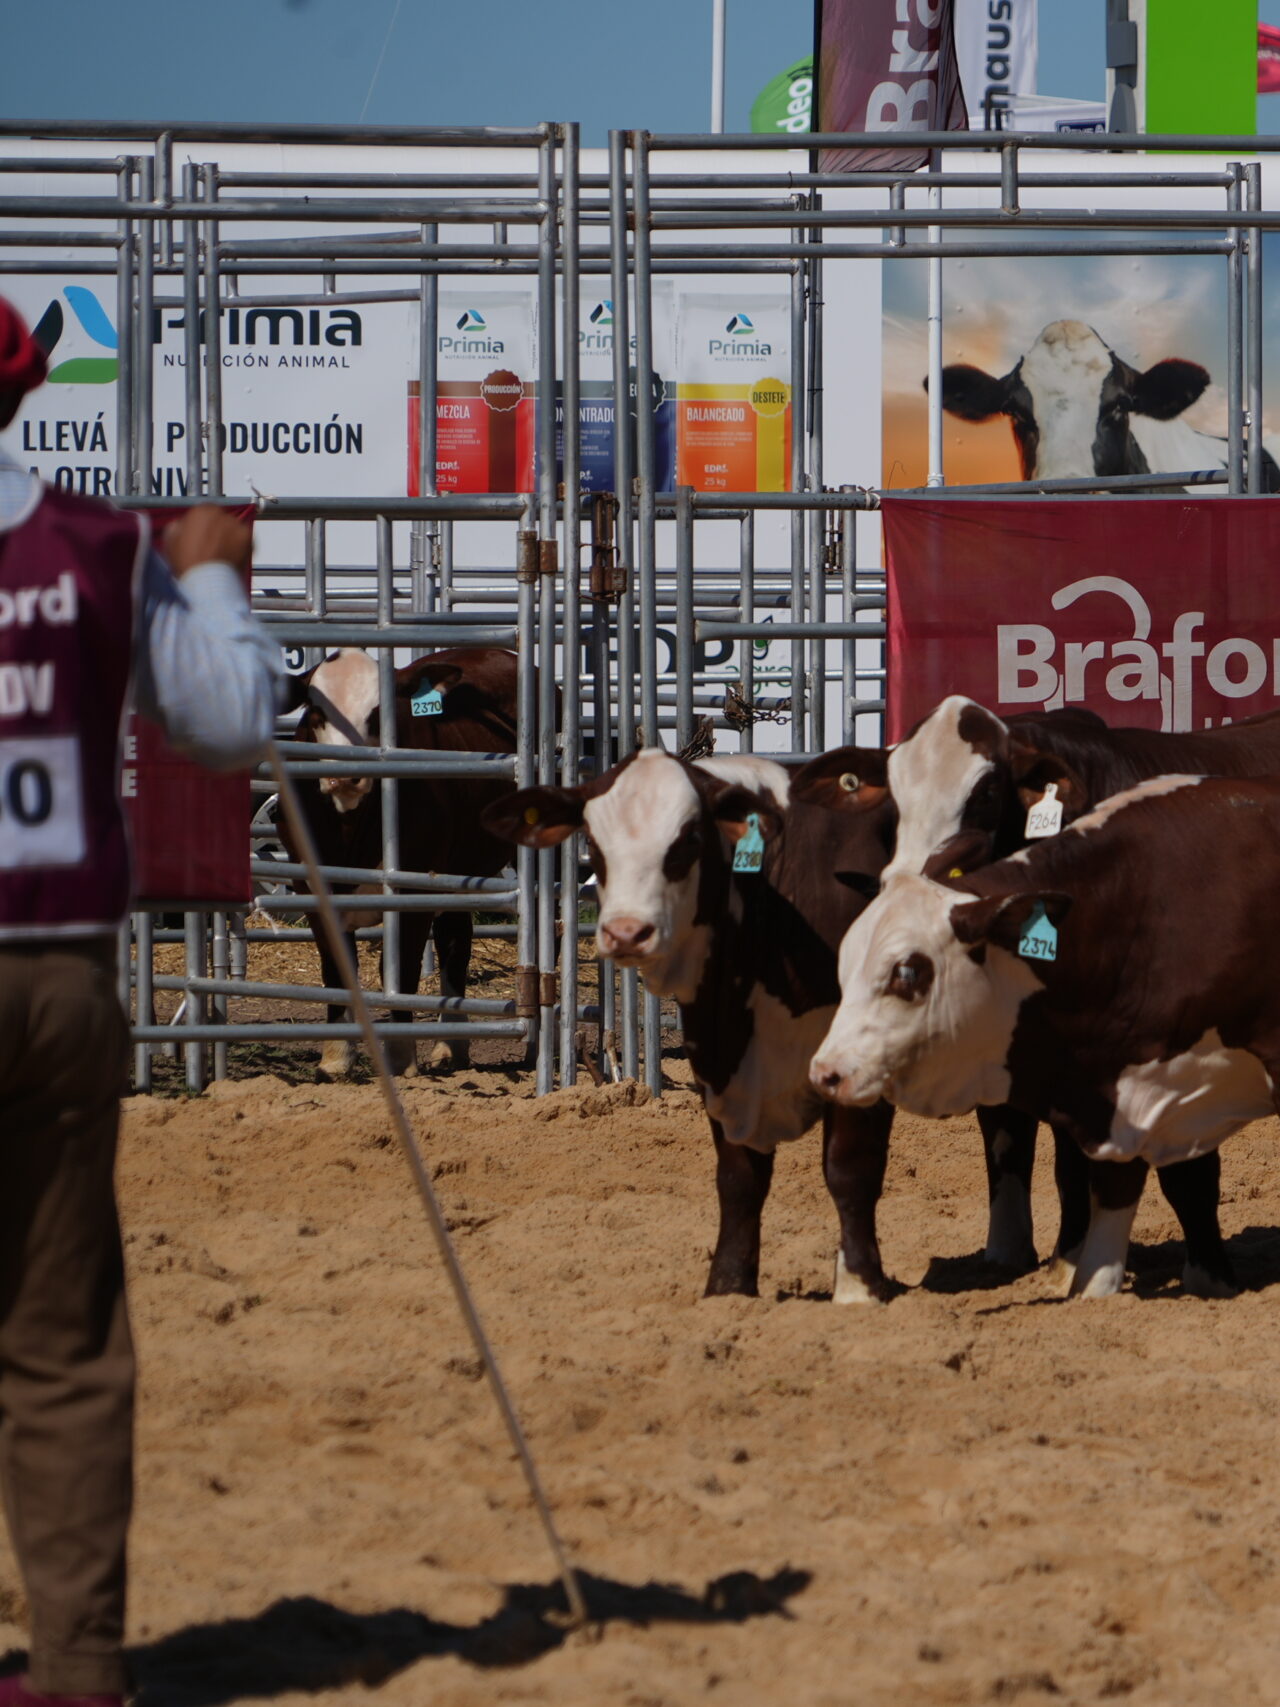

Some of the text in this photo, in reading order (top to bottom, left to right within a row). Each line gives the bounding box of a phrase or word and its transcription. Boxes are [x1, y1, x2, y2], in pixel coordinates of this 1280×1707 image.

[438, 336, 505, 353] Primia
[579, 330, 638, 348] Prima
[709, 338, 772, 356] Primia
[163, 352, 351, 368] NURCIÓN ANIMAL
[483, 383, 522, 394] PRODUCCIÓN
[752, 391, 785, 404] DESTETE
[686, 407, 745, 422] BALANCEADO
[23, 411, 363, 454] LLEVÁ PDUCCIÓN
[54, 466, 118, 496] OTR
[413, 700, 442, 715] 2370
[1029, 811, 1058, 829] F264
[1020, 936, 1056, 957] 2374
